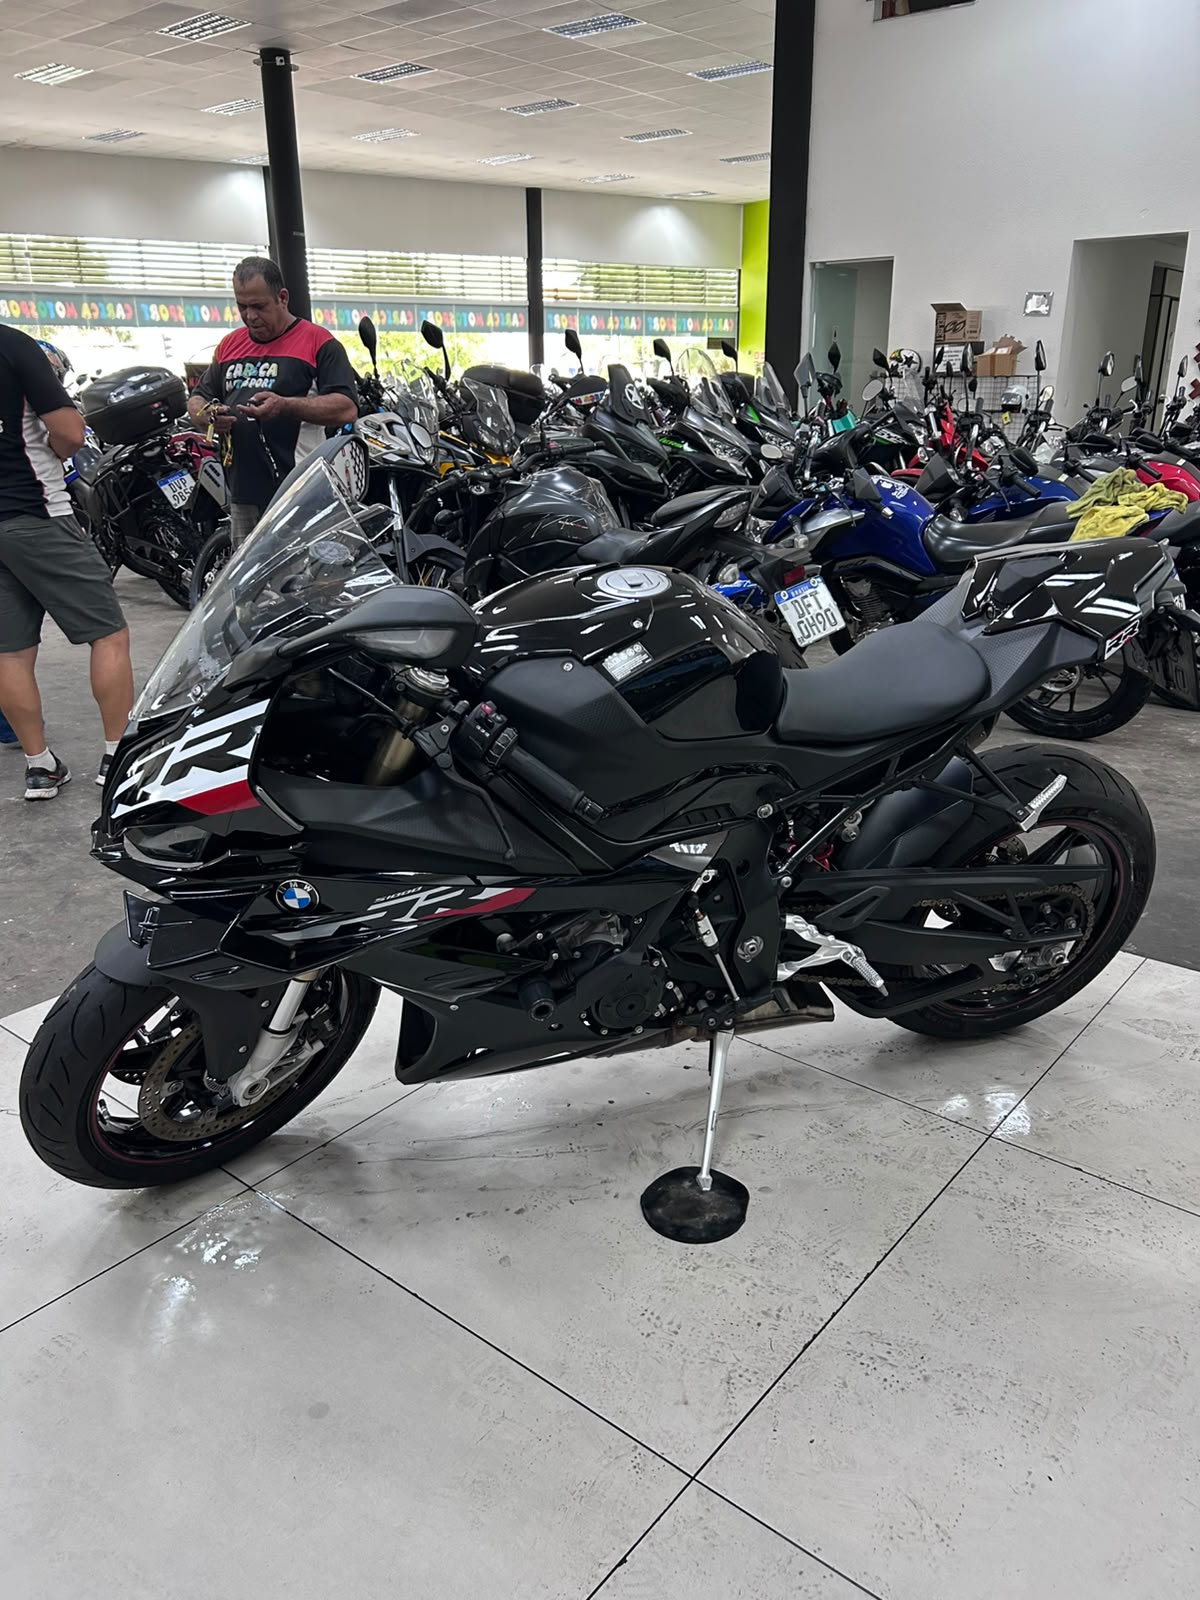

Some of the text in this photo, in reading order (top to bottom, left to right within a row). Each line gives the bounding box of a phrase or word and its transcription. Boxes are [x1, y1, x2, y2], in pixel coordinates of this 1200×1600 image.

[168, 477, 187, 493] DVP
[791, 591, 823, 619] DFT
[1104, 619, 1140, 660] RR
[374, 886, 423, 903] S1000
